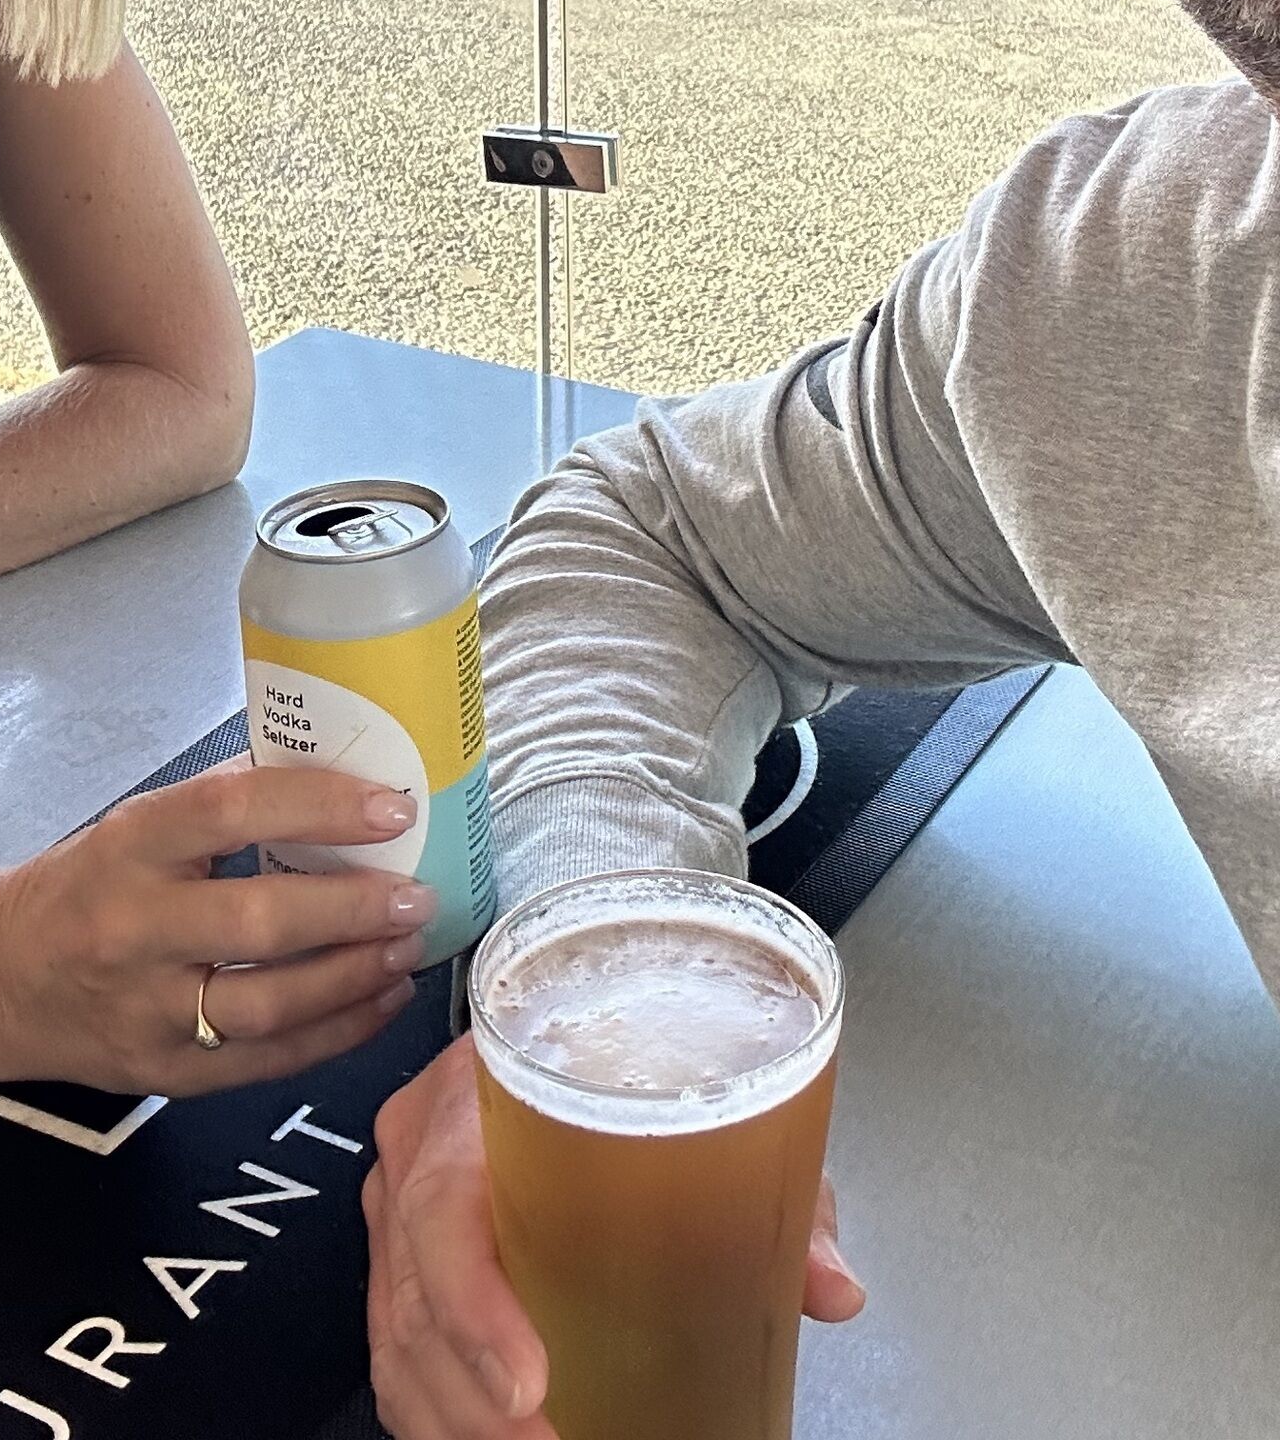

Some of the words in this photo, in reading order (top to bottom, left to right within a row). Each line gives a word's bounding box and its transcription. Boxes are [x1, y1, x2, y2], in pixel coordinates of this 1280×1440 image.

[266, 684, 304, 708] Hard
[263, 703, 312, 732] Vodka
[262, 725, 318, 753] Seltzer
